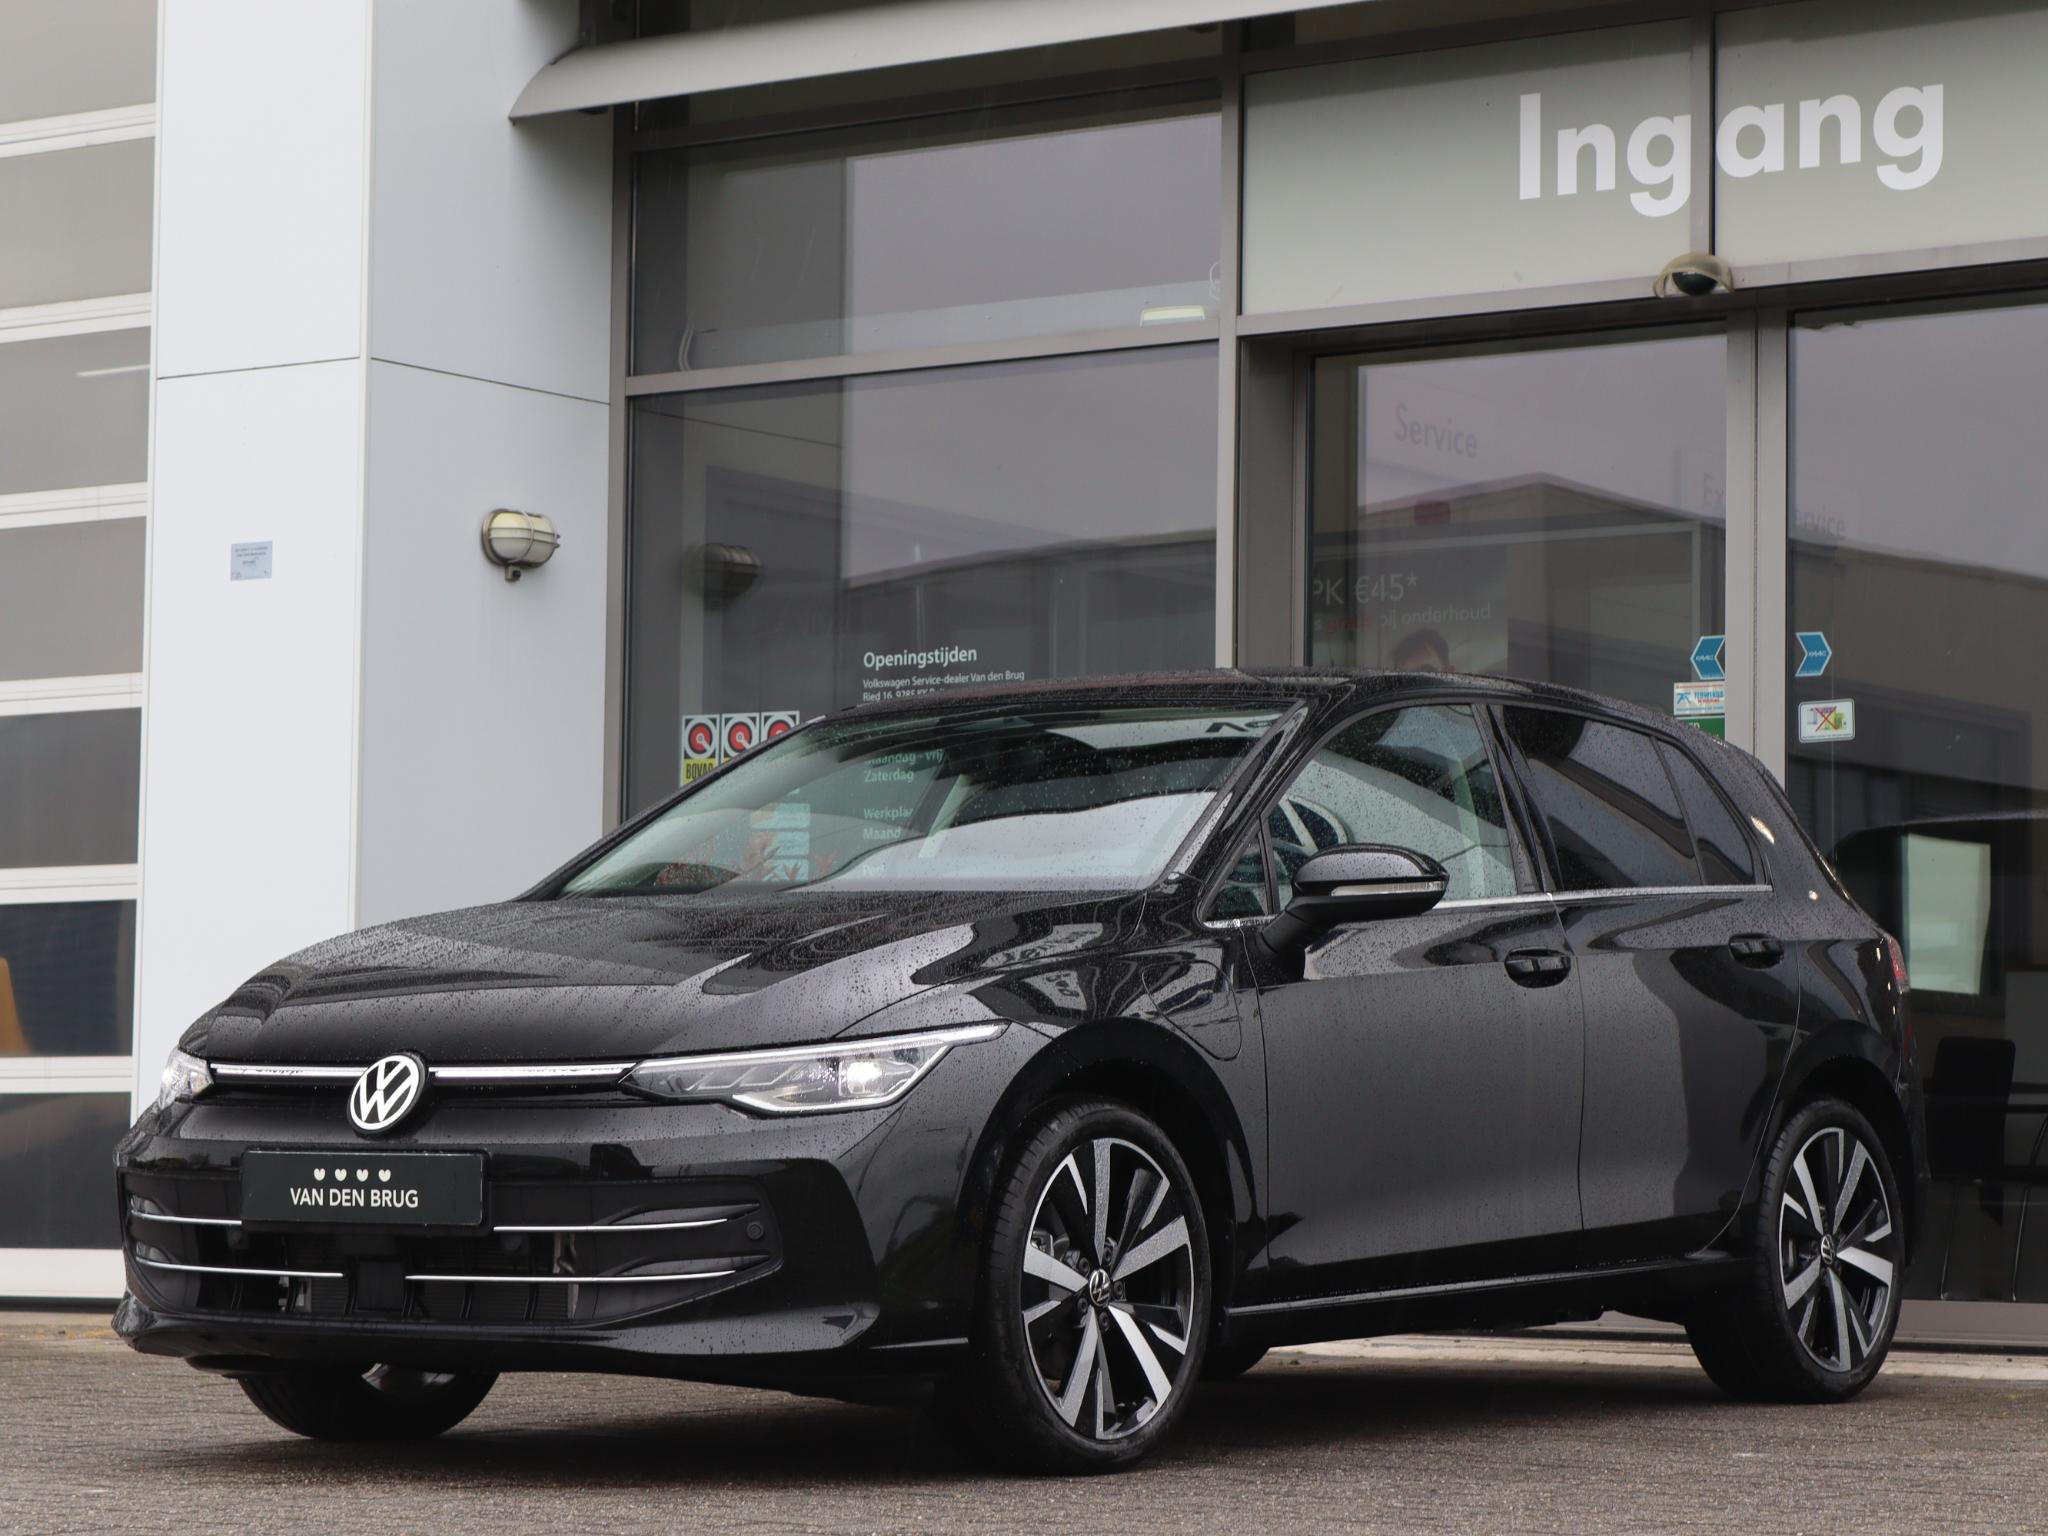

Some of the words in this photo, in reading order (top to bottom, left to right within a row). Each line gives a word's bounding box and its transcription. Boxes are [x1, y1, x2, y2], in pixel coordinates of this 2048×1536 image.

[1518, 83, 1945, 217] Ingang
[1393, 401, 1480, 459] Service
[1401, 601, 1491, 626] onderhoud
[863, 645, 978, 671] Openingstijden
[863, 678, 911, 690] Volkswagen
[970, 672, 986, 683] Van
[987, 671, 1004, 682] den
[1005, 669, 1025, 681] Brug
[864, 768, 914, 783] Zaterdag
[290, 1187, 324, 1206] VAN
[329, 1188, 365, 1207] DEN
[370, 1189, 419, 1208] BRUG
